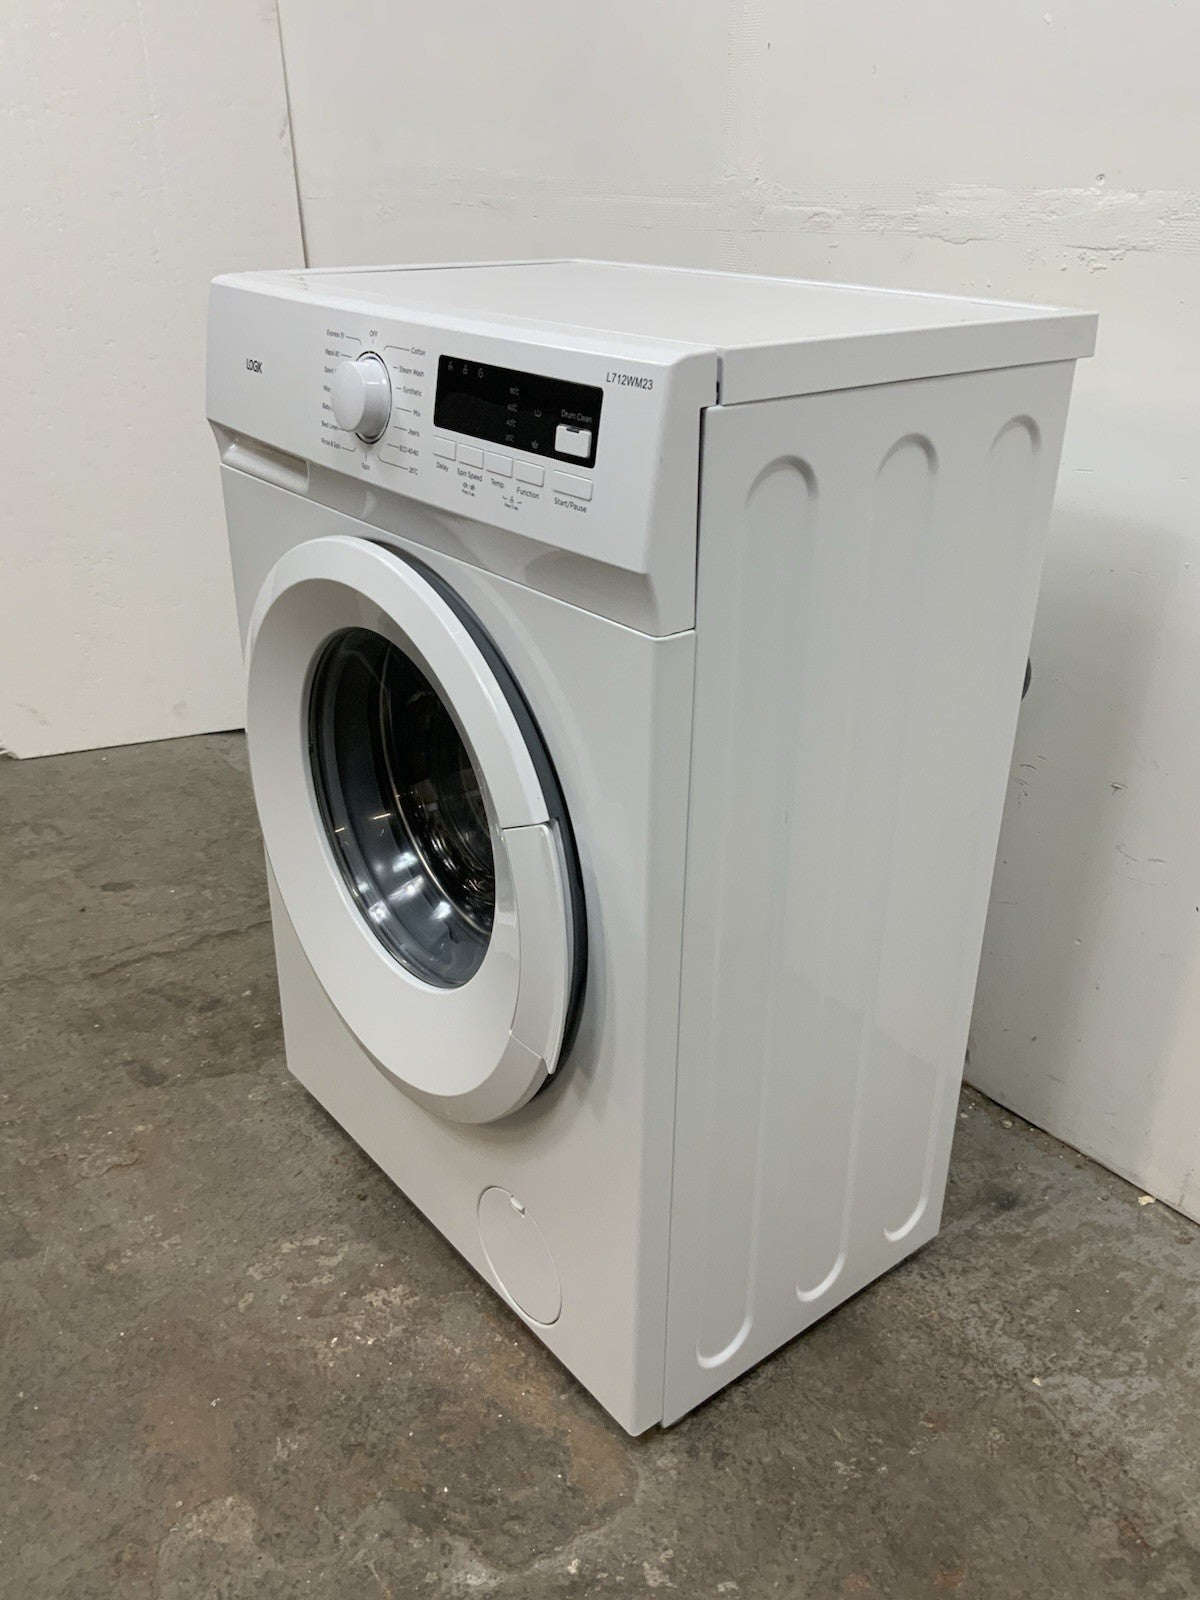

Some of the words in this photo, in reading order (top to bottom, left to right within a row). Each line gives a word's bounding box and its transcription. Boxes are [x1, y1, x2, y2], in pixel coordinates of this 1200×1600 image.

[411, 347, 426, 356] Cotton
[606, 371, 654, 391] L712WM23
[402, 385, 423, 398] Synthetic
[561, 409, 576, 419] Drum
[577, 412, 592, 423] Clean
[436, 461, 449, 472] Delay
[456, 467, 467, 477] Spin
[468, 470, 483, 482] Speed
[516, 486, 540, 500] Function
[554, 496, 587, 514] Start/Pause
